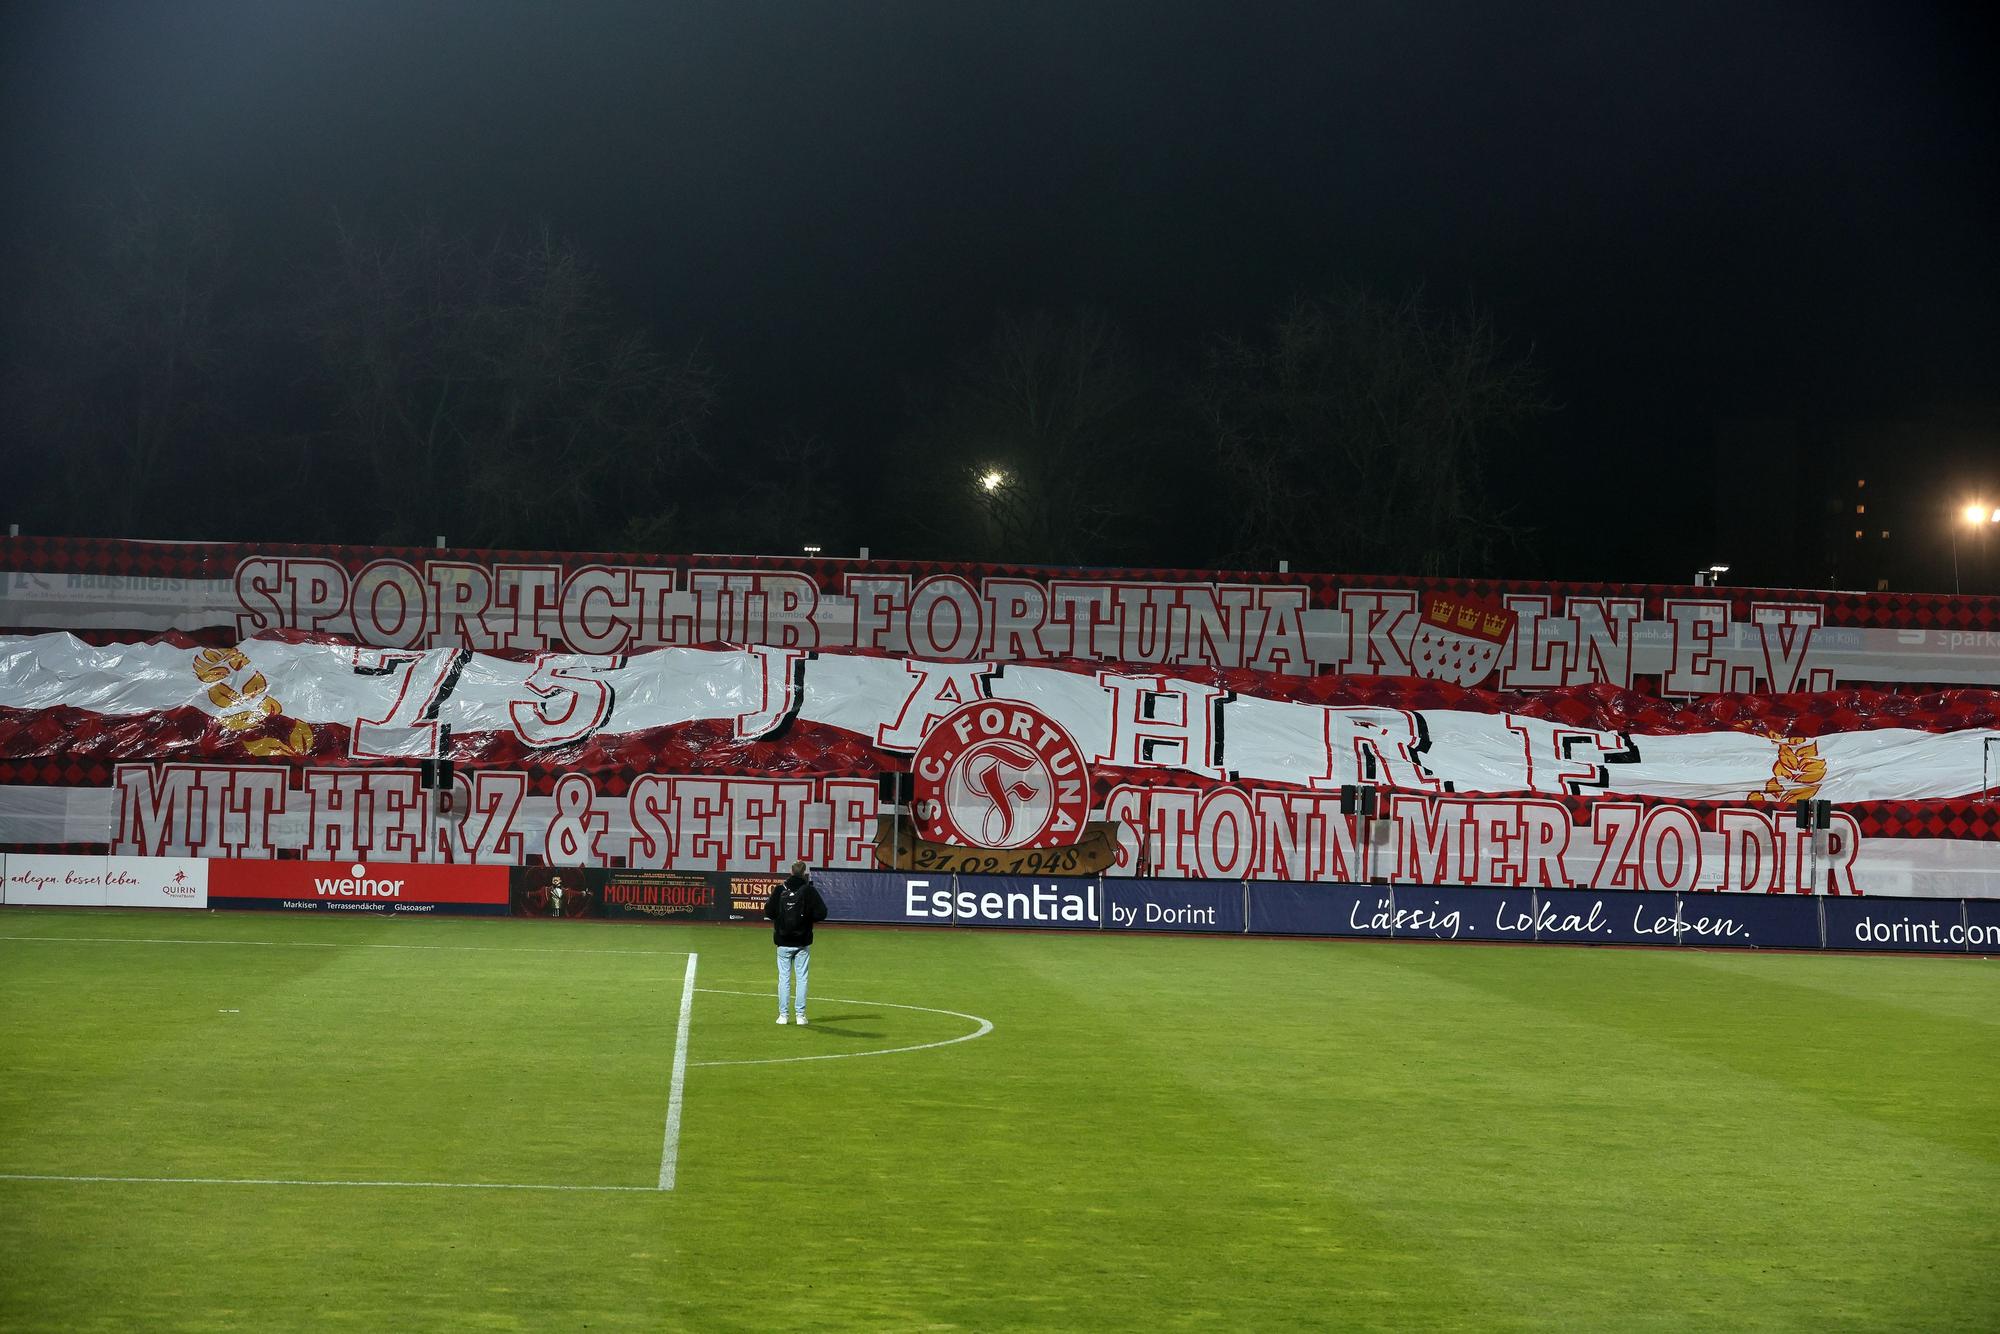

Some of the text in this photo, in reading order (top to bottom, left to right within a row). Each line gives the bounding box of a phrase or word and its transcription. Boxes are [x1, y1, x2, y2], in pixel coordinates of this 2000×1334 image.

[234, 555, 821, 655] SPORTCLUB
[844, 573, 1314, 677] FORTUNA
[1662, 598, 1836, 698] E.V.
[954, 707, 1082, 832] FORTUNA
[111, 763, 291, 858] MIT
[302, 766, 528, 864] HERZ
[545, 772, 609, 868] &
[627, 773, 880, 870] SEELE
[1390, 793, 1575, 888] MER
[1592, 801, 1703, 892] ZO
[1717, 808, 1864, 897] DIR
[11, 870, 59, 890] anlegen.
[65, 870, 100, 885] besser
[105, 871, 140, 886] leben.
[162, 886, 196, 895] QUIRIN
[314, 863, 404, 897] weinor
[604, 885, 716, 906] MOULIN ROUGE!
[283, 901, 317, 909] Markisen
[326, 902, 386, 911] Terrassendächer
[733, 901, 759, 910] MUSICAL
[905, 880, 1215, 926] Essential by Dorint
[1349, 899, 1750, 939] Lässig. Lokal. Leben.
